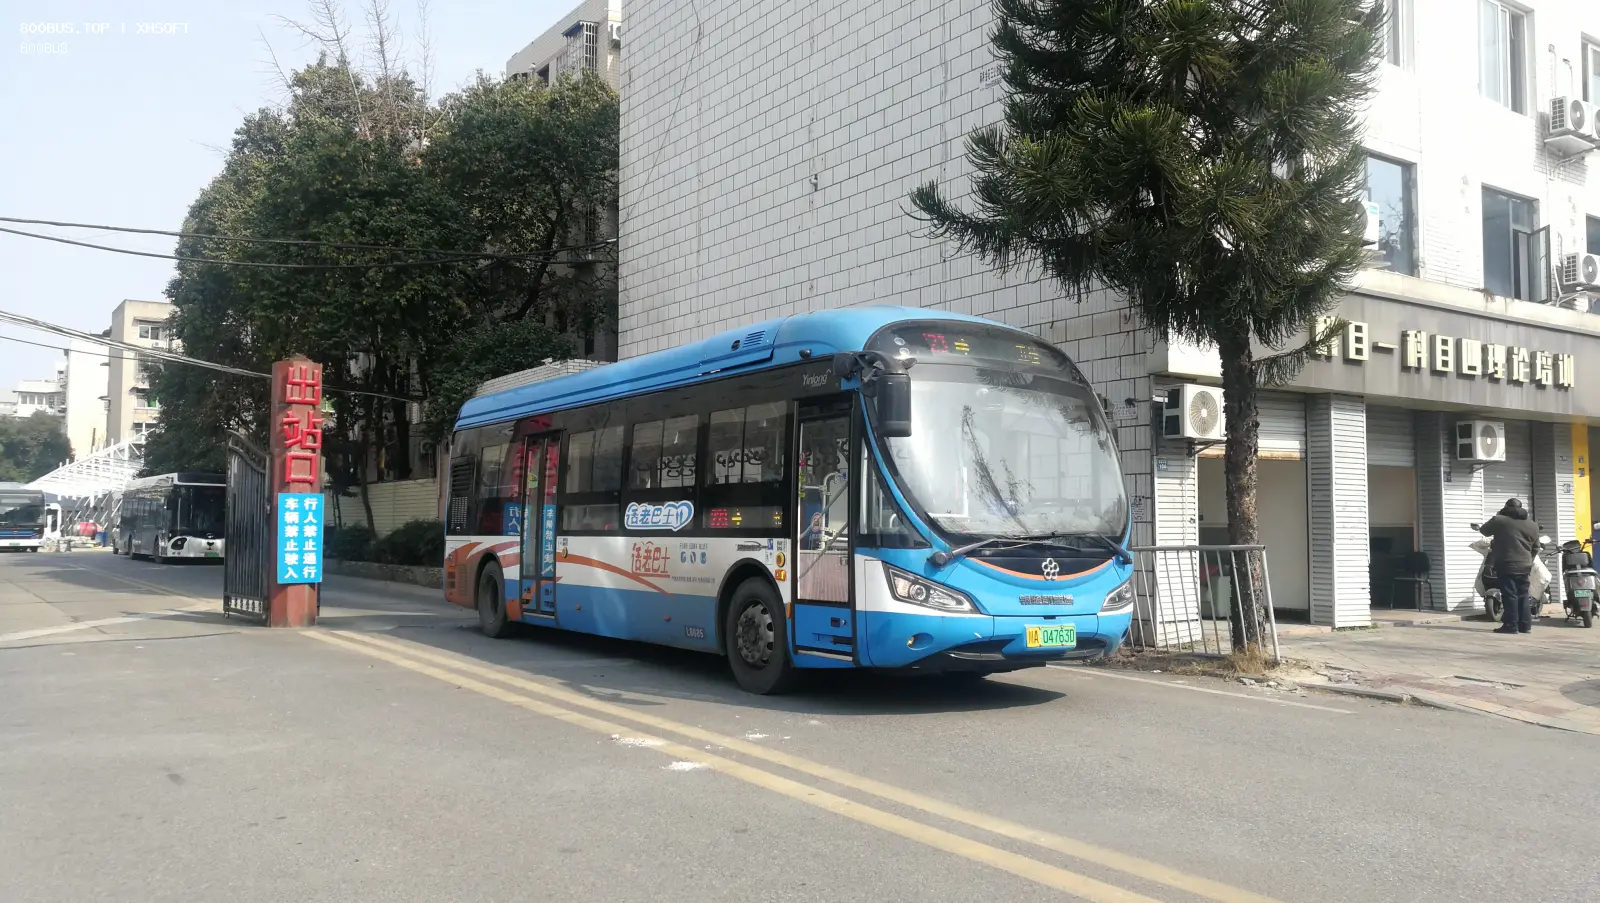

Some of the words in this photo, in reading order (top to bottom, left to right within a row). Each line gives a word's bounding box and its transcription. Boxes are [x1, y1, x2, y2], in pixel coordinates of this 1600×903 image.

[283, 365, 324, 483] 出站口
[284, 497, 300, 580] 车辆禁止驶入
[303, 497, 318, 580] 行人禁止通行
